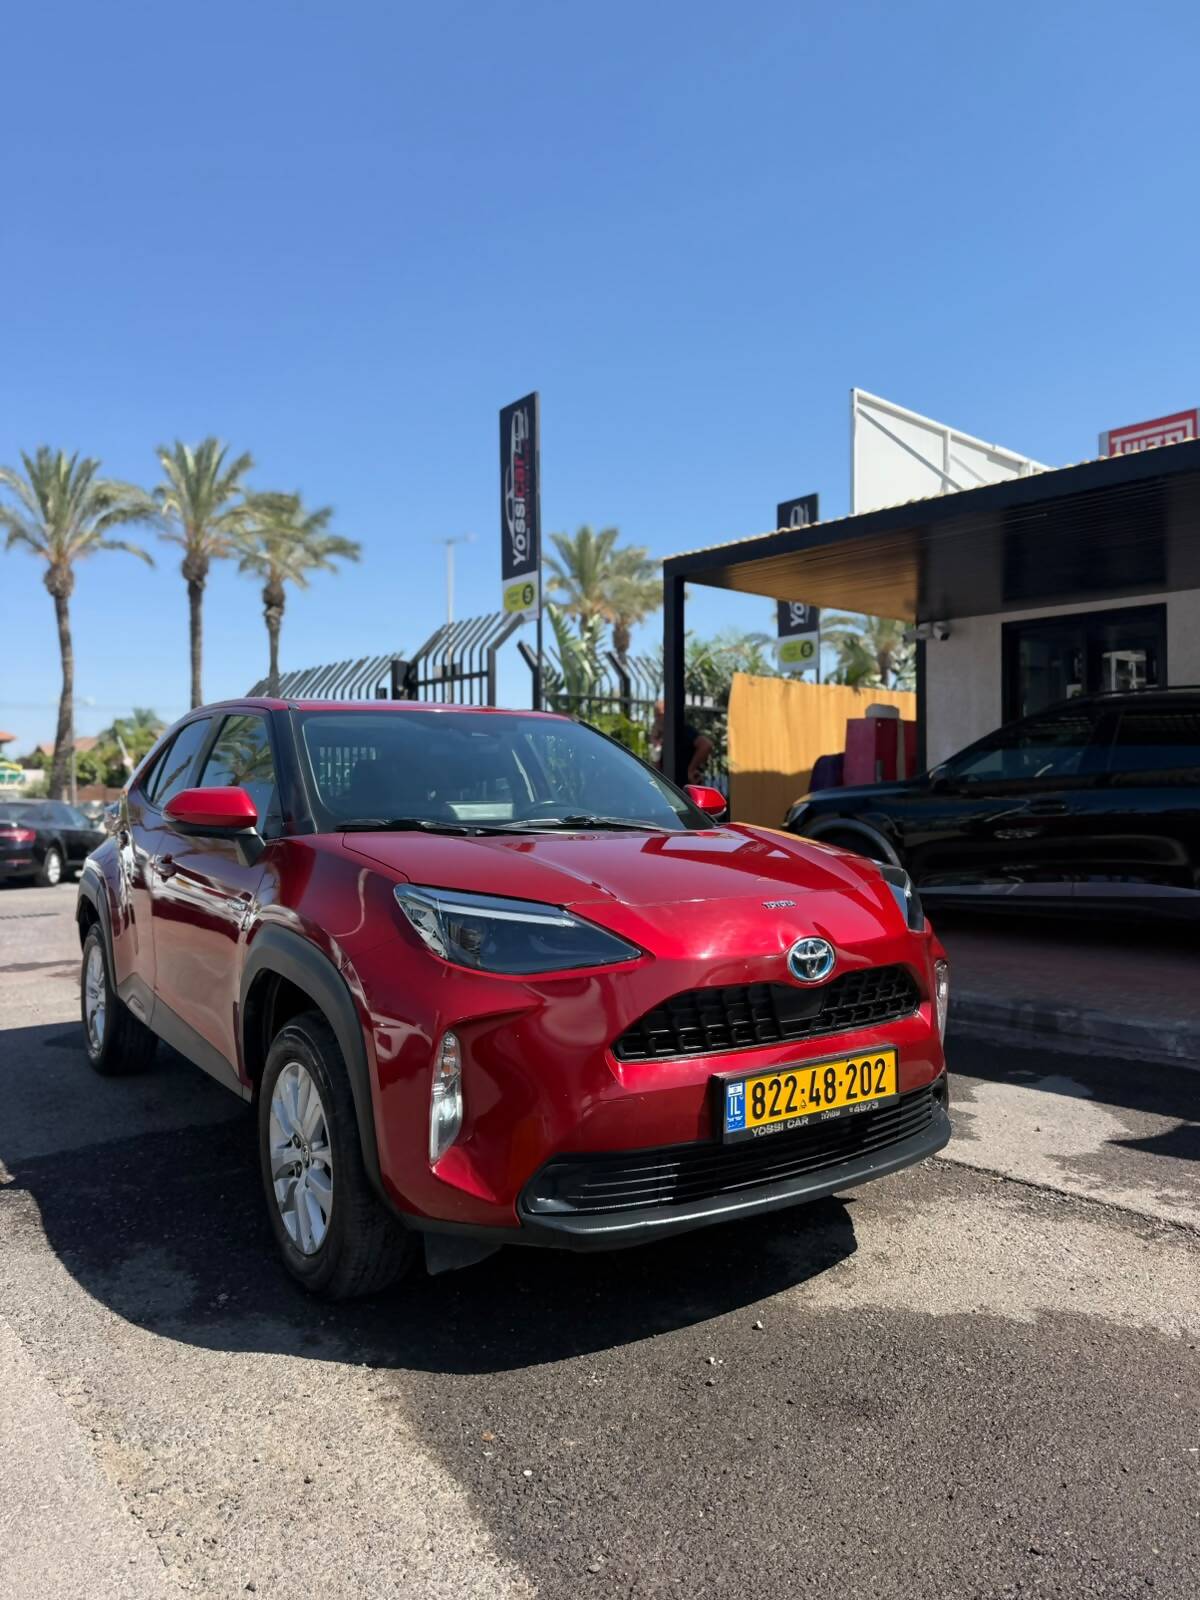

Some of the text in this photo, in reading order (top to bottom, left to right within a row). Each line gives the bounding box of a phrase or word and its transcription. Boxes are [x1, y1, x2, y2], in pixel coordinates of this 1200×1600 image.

[730, 1096, 741, 1116] IL
[751, 1123, 784, 1137] YOSSI
[787, 1116, 809, 1129] CAR
